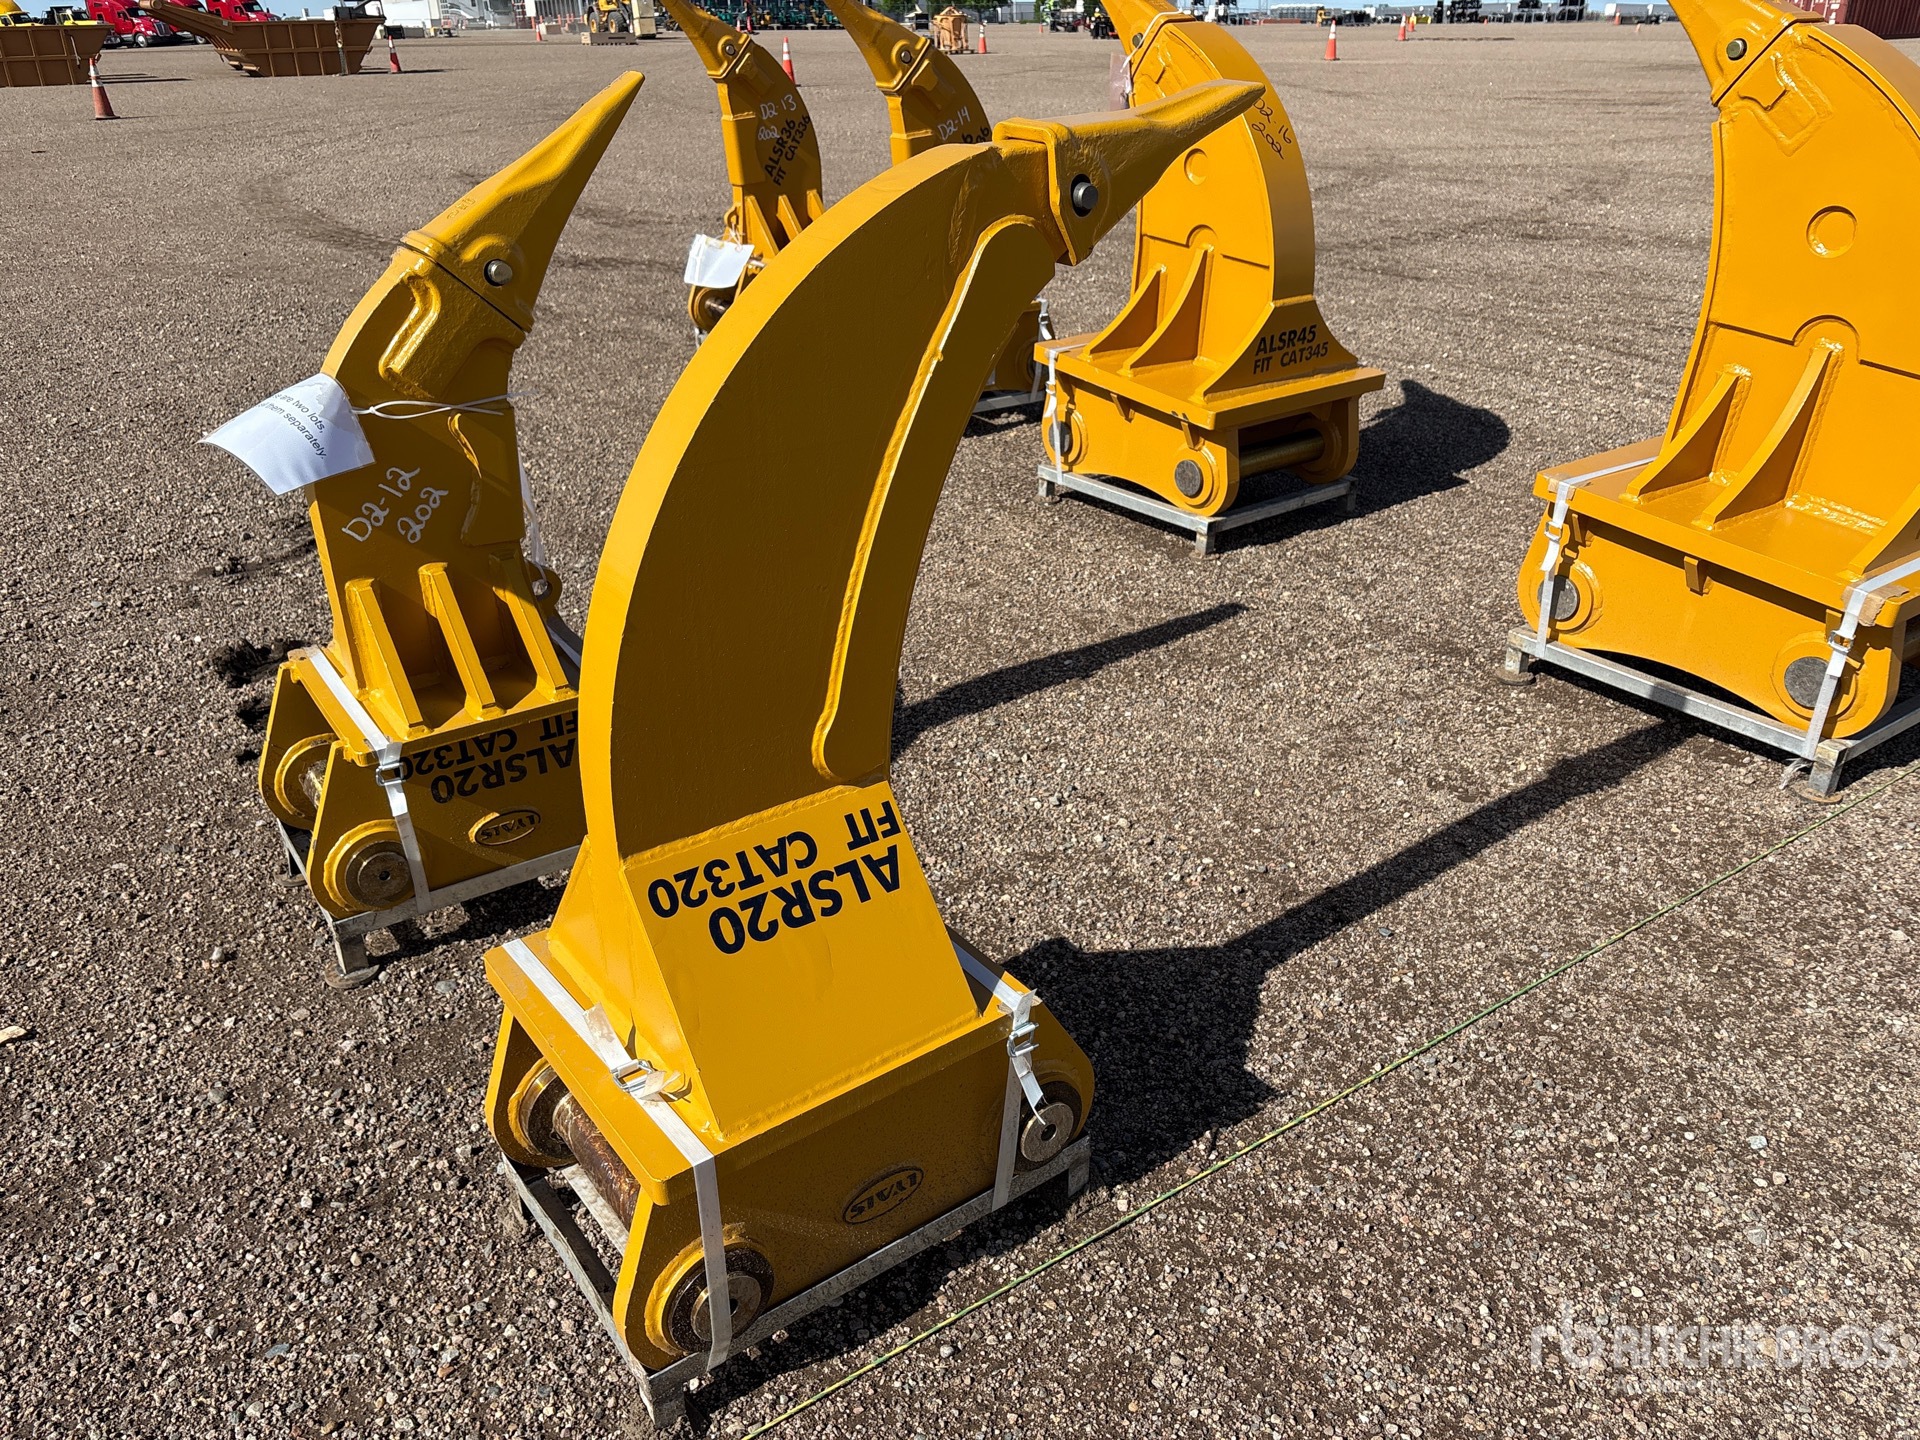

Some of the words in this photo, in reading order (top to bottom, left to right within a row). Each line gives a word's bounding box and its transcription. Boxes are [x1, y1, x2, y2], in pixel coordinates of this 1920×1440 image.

[765, 120, 796, 177] ALSR36
[937, 105, 970, 140] D2-14
[773, 167, 786, 186] FIT
[785, 115, 811, 161] CAT336
[1253, 356, 1273, 375] FIT
[1280, 342, 1329, 367] CAT345
[1255, 325, 1317, 356] ALSR45
[292, 399, 310, 413] two
[283, 412, 327, 460] separately.
[342, 467, 420, 542] D2-12
[397, 487, 449, 544] 202
[539, 710, 578, 742] FIT
[394, 728, 518, 781] CAT320
[431, 738, 576, 804] ALSR20
[844, 801, 901, 851] FIT
[648, 831, 818, 918] CAT320
[709, 844, 900, 954] ALSR20
